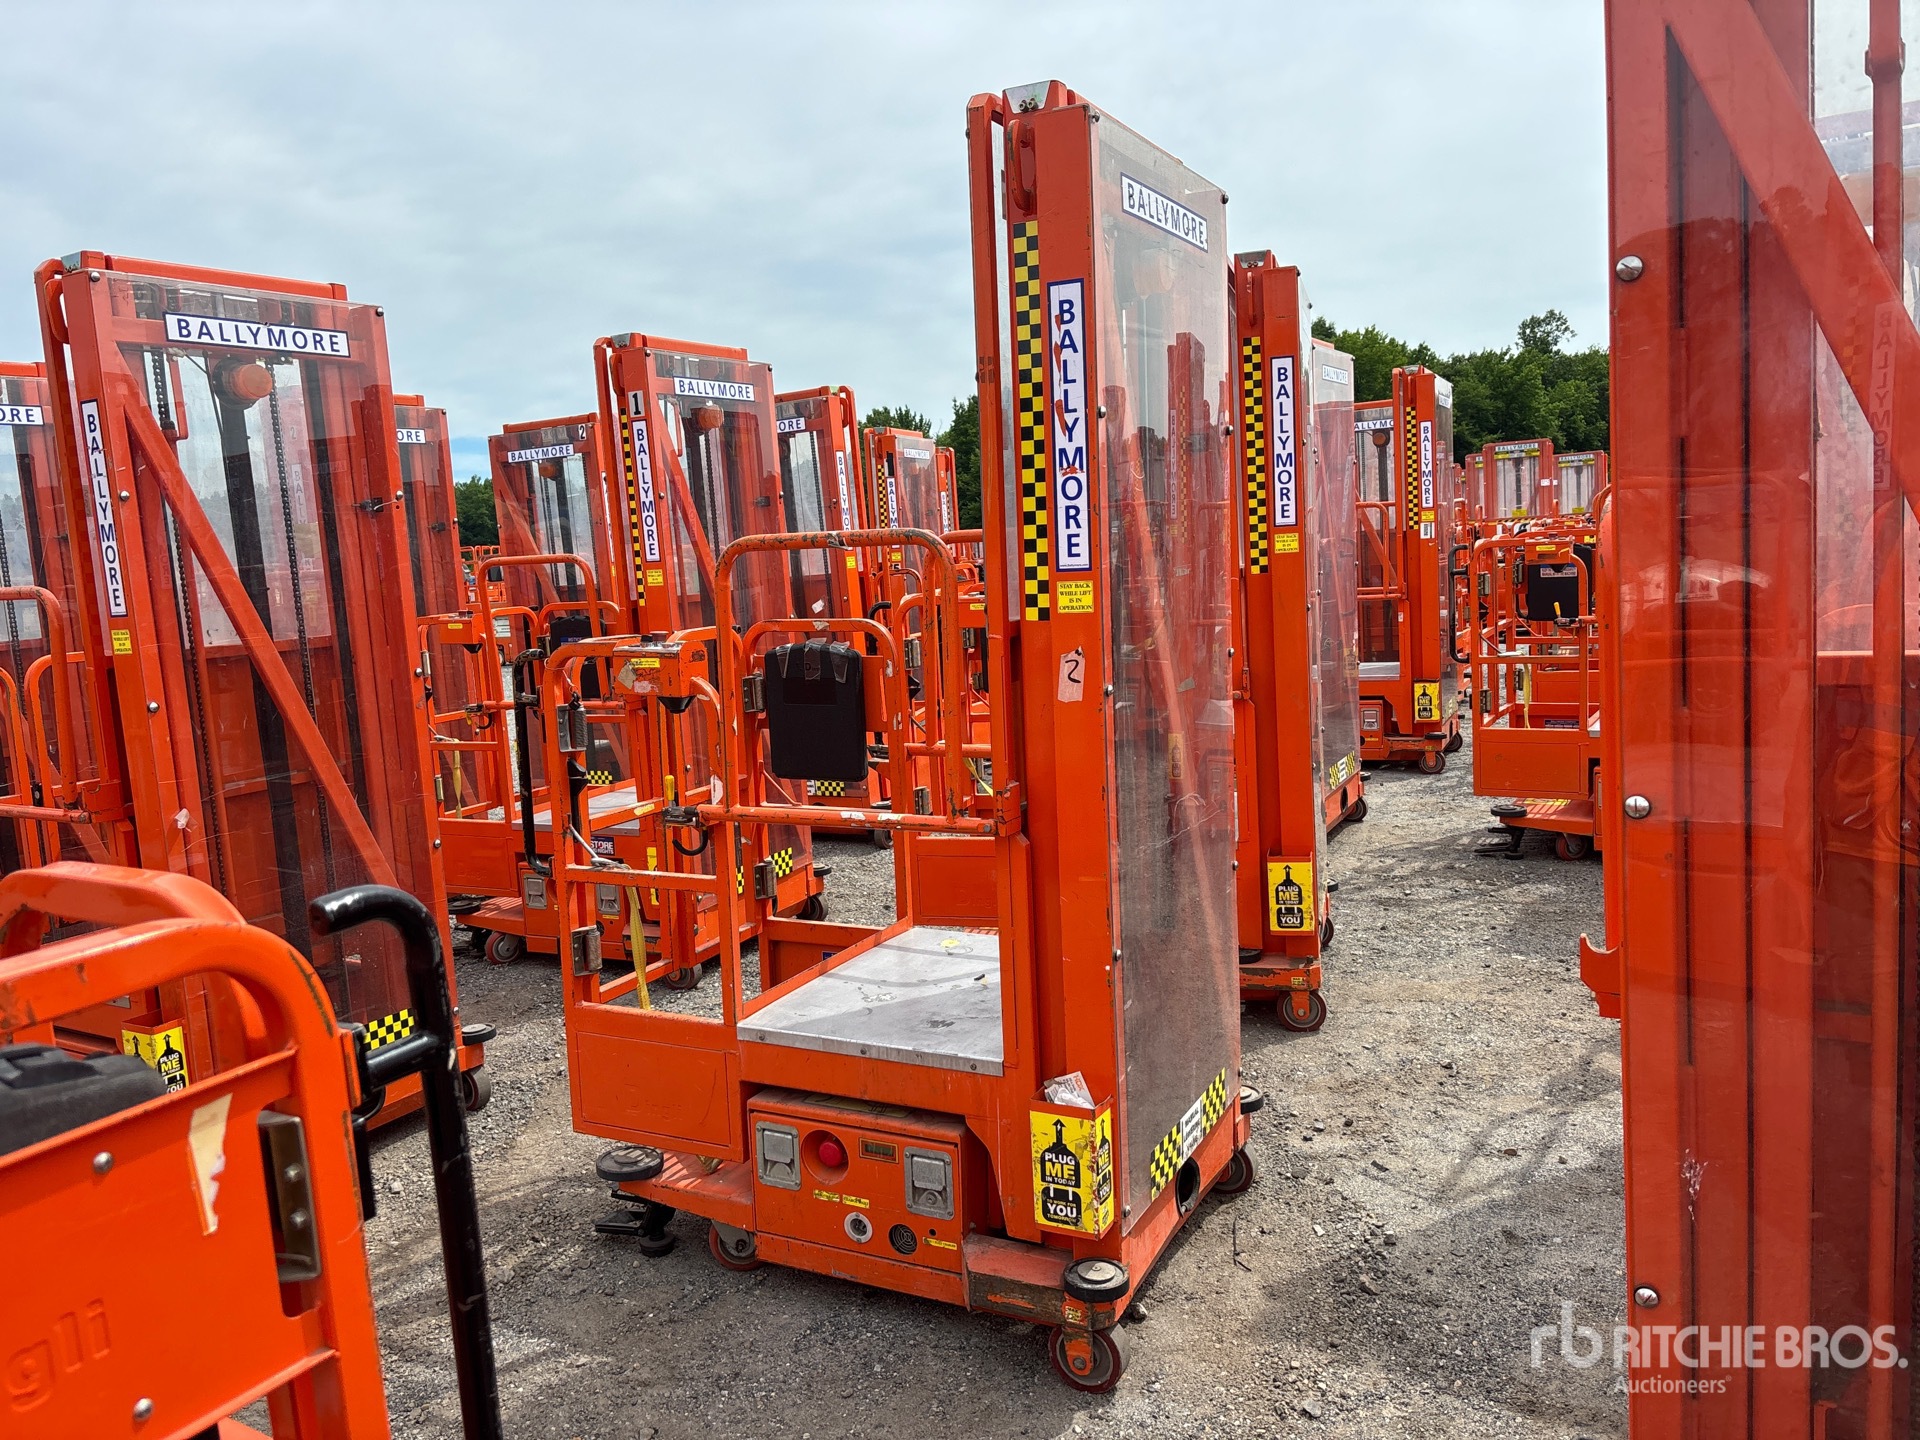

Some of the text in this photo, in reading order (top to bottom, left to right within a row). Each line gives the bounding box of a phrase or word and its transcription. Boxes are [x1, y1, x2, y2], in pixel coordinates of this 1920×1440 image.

[1127, 182, 1204, 245] BALLYMORE
[177, 317, 341, 352] BALLYMORE
[678, 379, 751, 399] BALLYMORE
[631, 392, 641, 415] 1
[579, 425, 585, 439] 2
[1058, 298, 1084, 558] BALLYMORE
[1354, 420, 1393, 430] ALLYMO
[1276, 366, 1293, 519] BALLYMORE
[511, 445, 571, 461] BALLYMORE
[1422, 426, 1432, 505] BALLYMORE
[636, 428, 656, 556] BALLYMORE
[838, 456, 850, 531] BALLYMO
[87, 413, 122, 607] BALLYMORE
[888, 481, 898, 529] BALLYM
[1065, 659, 1081, 683] 2
[1279, 891, 1299, 901] ME
[1280, 916, 1300, 924] YOU
[160, 1053, 179, 1064] PLUG
[161, 1058, 180, 1073] ME
[1045, 1152, 1075, 1165] PLUG
[1045, 1161, 1075, 1180] ME
[1054, 1177, 1076, 1186] TODAY
[1047, 1203, 1077, 1218] YOU
